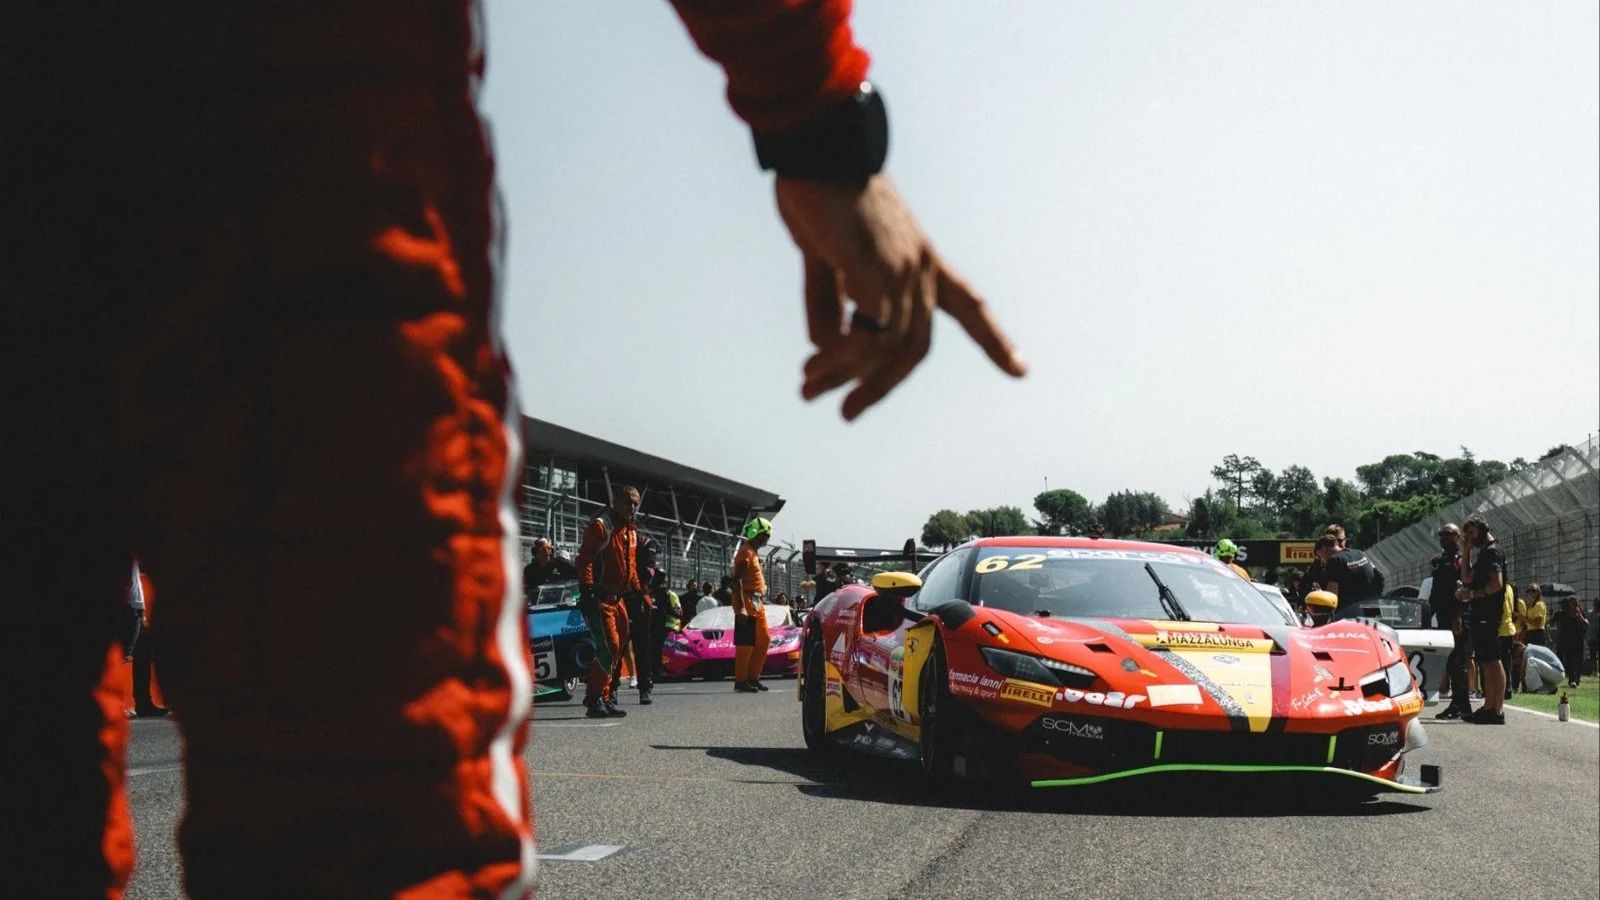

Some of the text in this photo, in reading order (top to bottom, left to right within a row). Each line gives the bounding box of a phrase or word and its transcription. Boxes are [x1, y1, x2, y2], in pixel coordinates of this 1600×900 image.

[976, 555, 1047, 574] 62
[1167, 636, 1254, 648] PIAZZALUNGA
[1001, 682, 1052, 704] PIRELLI
[1042, 717, 1089, 736] SCM
